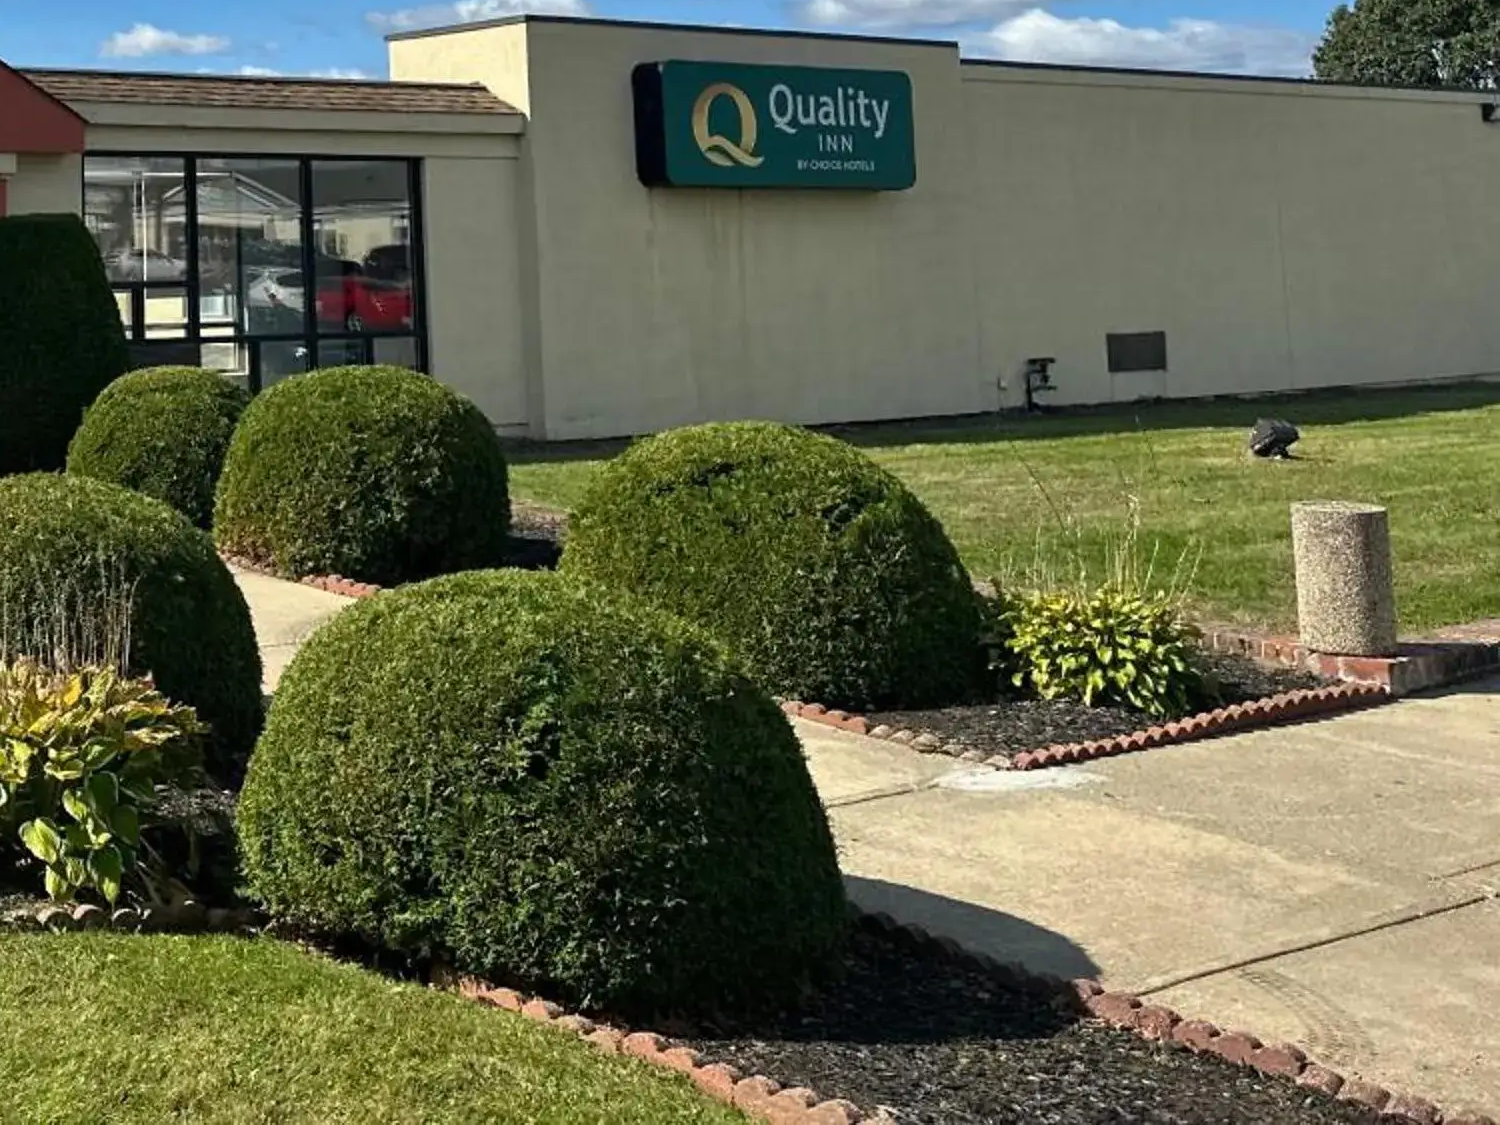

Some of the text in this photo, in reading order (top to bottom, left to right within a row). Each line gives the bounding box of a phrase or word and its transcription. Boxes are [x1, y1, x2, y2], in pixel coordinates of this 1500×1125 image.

[692, 82, 765, 168] Q
[769, 83, 890, 139] Quality
[818, 134, 853, 153] INN
[797, 159, 809, 171] BY
